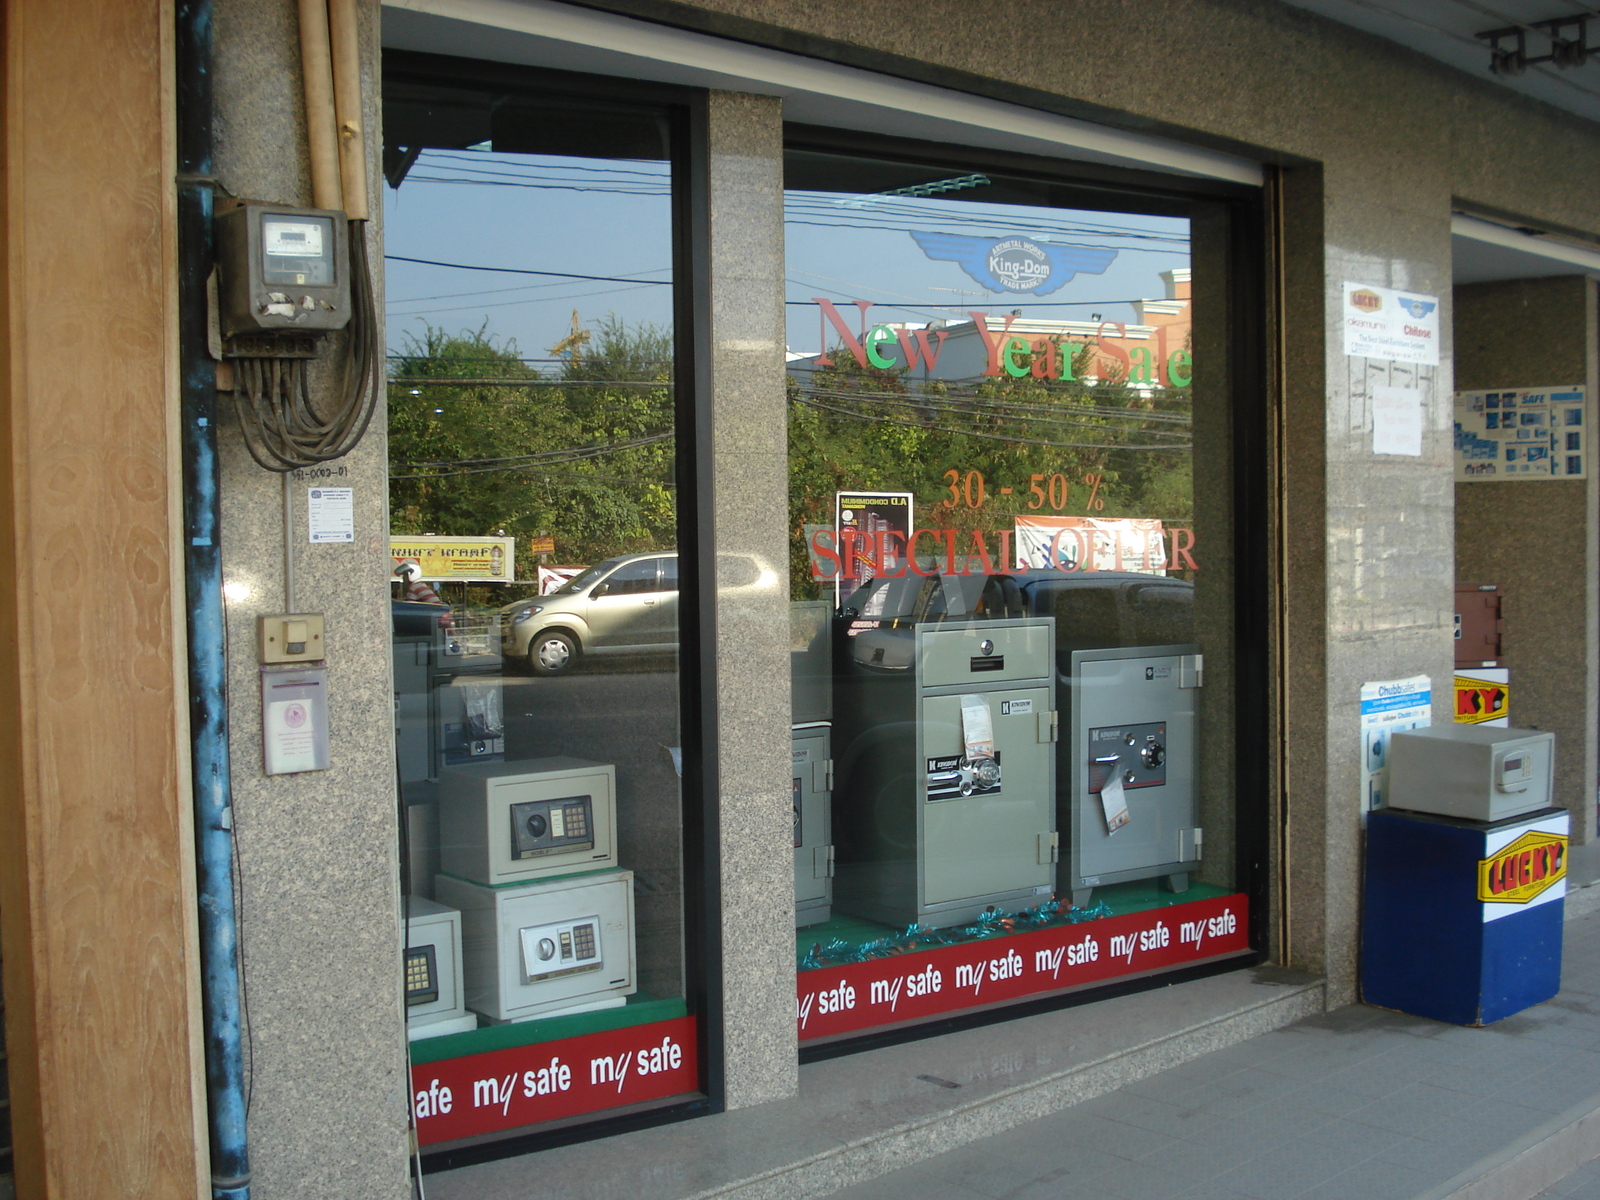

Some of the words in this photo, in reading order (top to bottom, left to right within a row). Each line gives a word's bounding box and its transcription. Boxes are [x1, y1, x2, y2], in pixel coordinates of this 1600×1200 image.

[992, 240, 1022, 255] ARTMETAL
[1023, 241, 1046, 260] WORKS
[989, 256, 1050, 280] King-Dom
[1000, 276, 1019, 289] TRADE
[1020, 278, 1039, 290] MARK
[811, 298, 949, 373] New
[968, 310, 1083, 381] Year
[1097, 321, 1192, 388] Sale
[1522, 394, 1546, 404] SAFE
[942, 469, 984, 509] 30
[1027, 473, 1068, 510] 50
[1085, 472, 1105, 511] %
[811, 528, 1029, 579] SPECIAL
[1051, 527, 1200, 573] OFFER
[1378, 682, 1416, 697] Chubbsafes
[1457, 687, 1502, 714] KY
[1489, 842, 1564, 895] LUCKY
[818, 980, 856, 1014] safe
[870, 975, 903, 1012] my
[906, 964, 942, 998] safe
[955, 960, 986, 996] my
[989, 949, 1023, 982] safe
[1035, 945, 1065, 979] my
[1067, 934, 1099, 966] safe
[1110, 931, 1139, 965] my
[1140, 921, 1170, 952] safe
[1180, 918, 1206, 951] my
[1207, 908, 1237, 939] safe
[416, 1078, 453, 1119] afe
[473, 1072, 518, 1116] my
[523, 1057, 571, 1098] safe
[590, 1051, 632, 1094] my
[637, 1036, 682, 1076] safe
